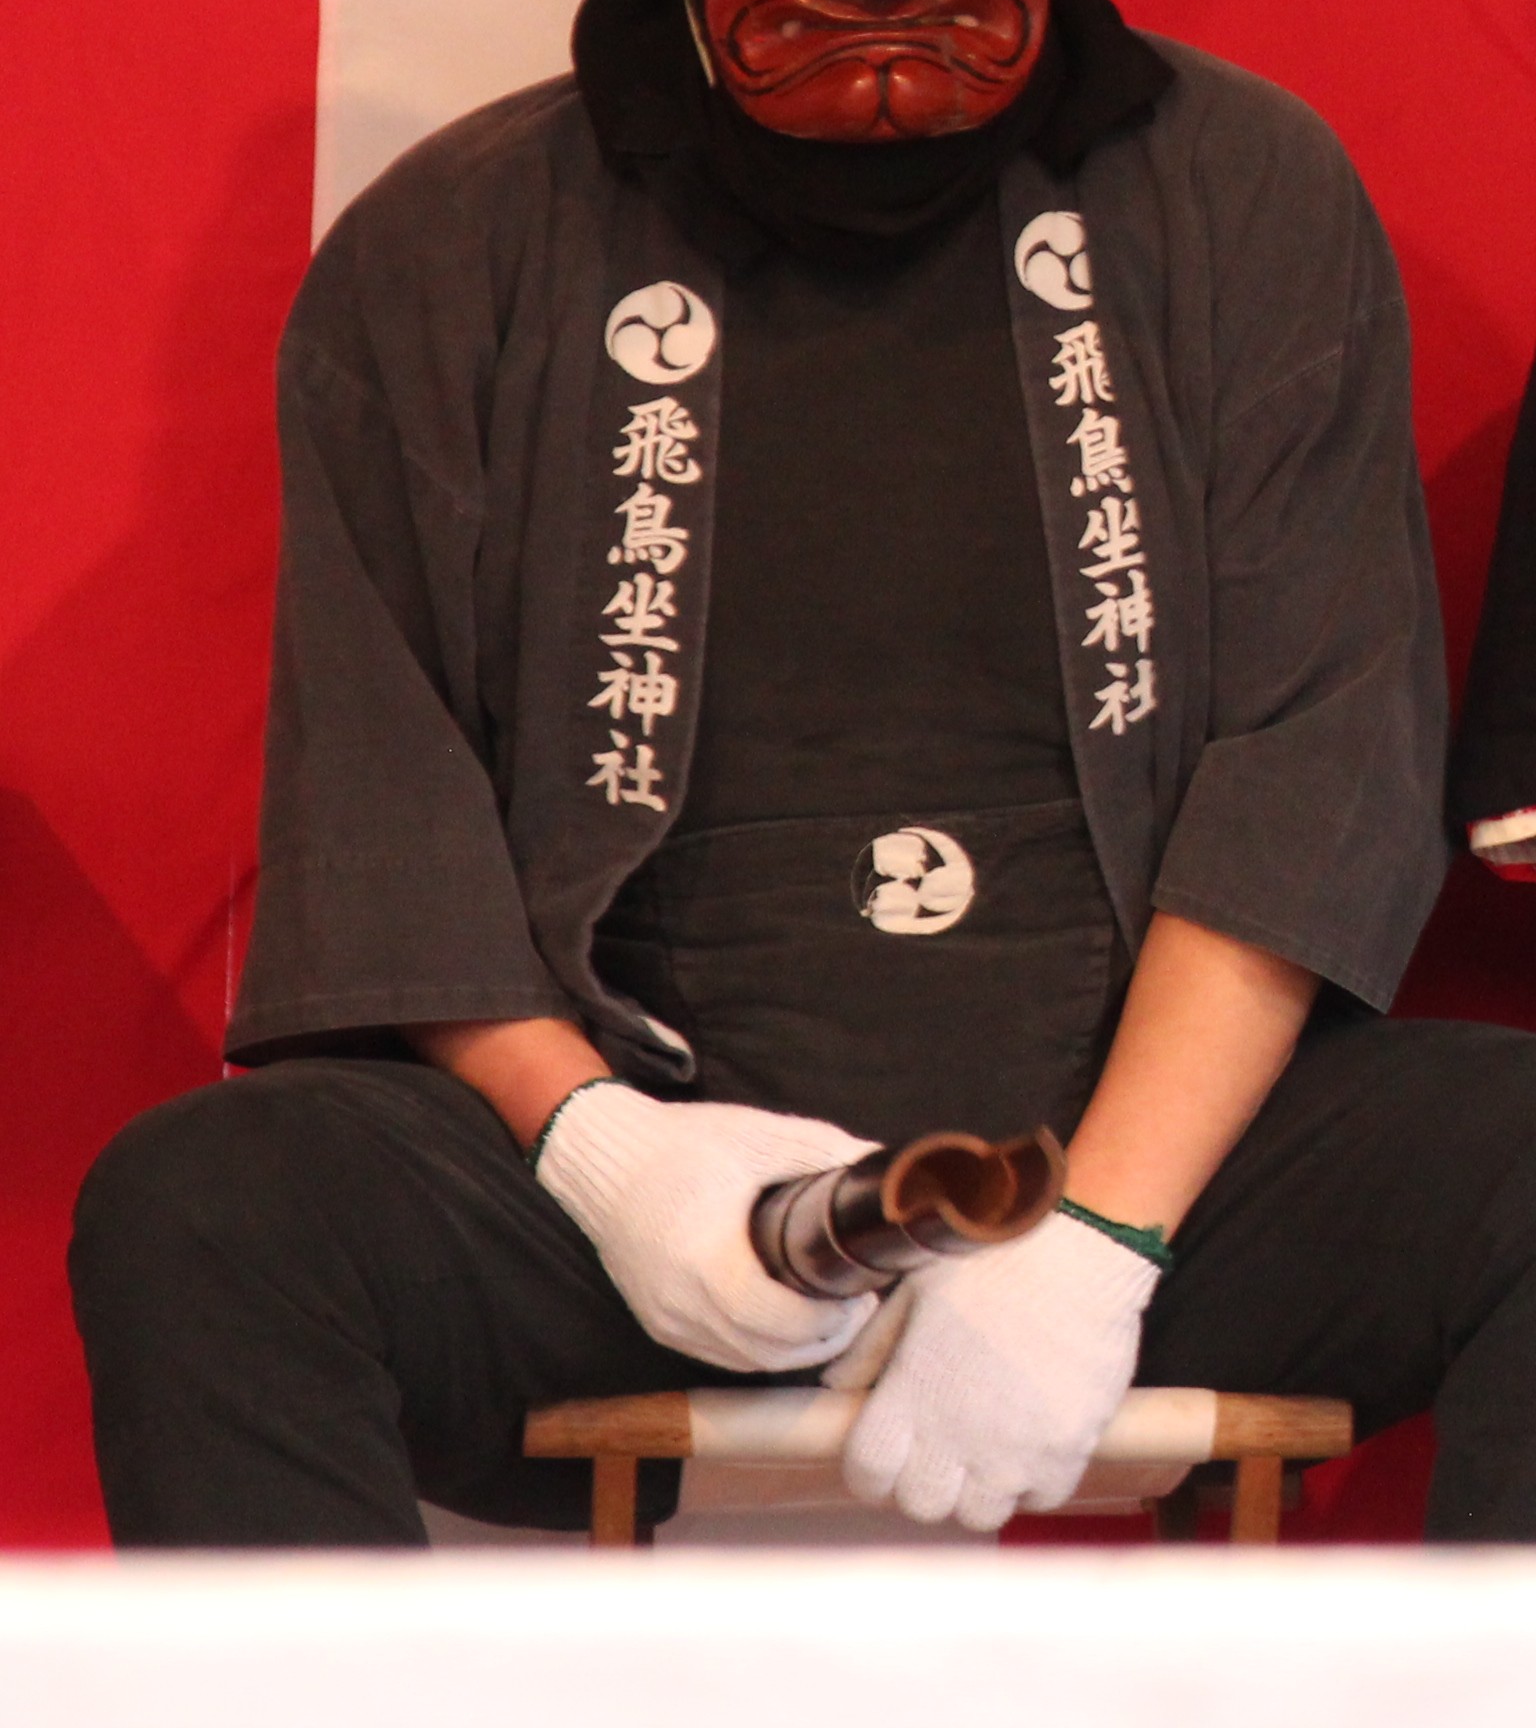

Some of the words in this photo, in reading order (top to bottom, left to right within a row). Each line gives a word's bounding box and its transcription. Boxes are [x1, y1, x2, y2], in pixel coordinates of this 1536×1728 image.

[586, 395, 701, 814] 飛鳥坐神社
[1048, 320, 1158, 737] 飛鳥坐神社
